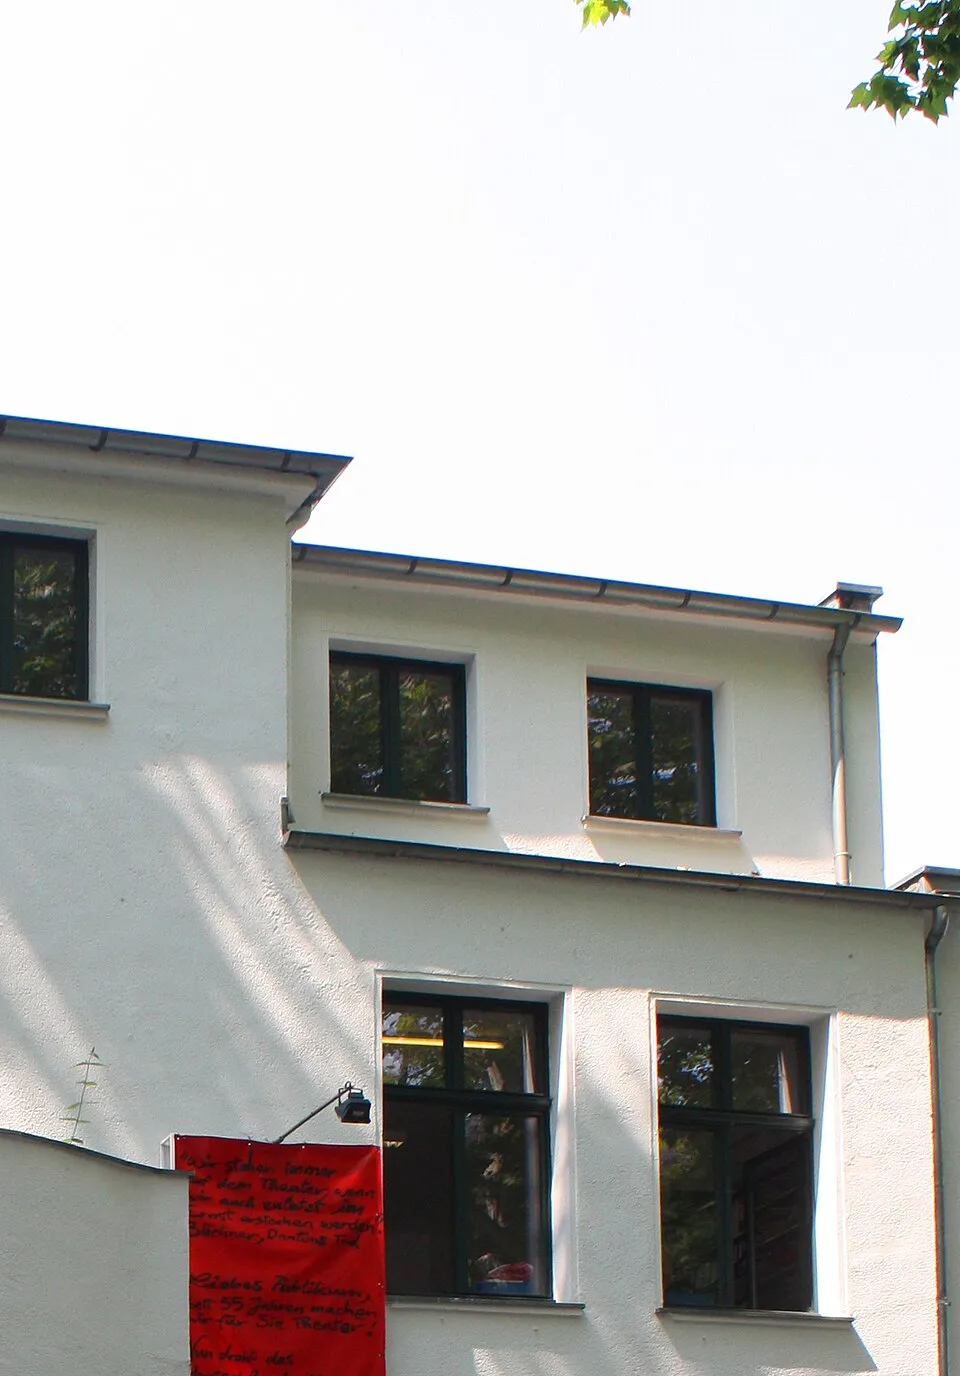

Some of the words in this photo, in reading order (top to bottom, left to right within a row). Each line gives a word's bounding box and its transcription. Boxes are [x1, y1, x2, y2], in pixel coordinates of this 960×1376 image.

[219, 1196, 254, 1209] auch
[221, 1296, 244, 1312] 55
[247, 1297, 306, 1317] Jahren
[256, 1314, 284, 1328] Sie
[265, 1350, 294, 1366] das
